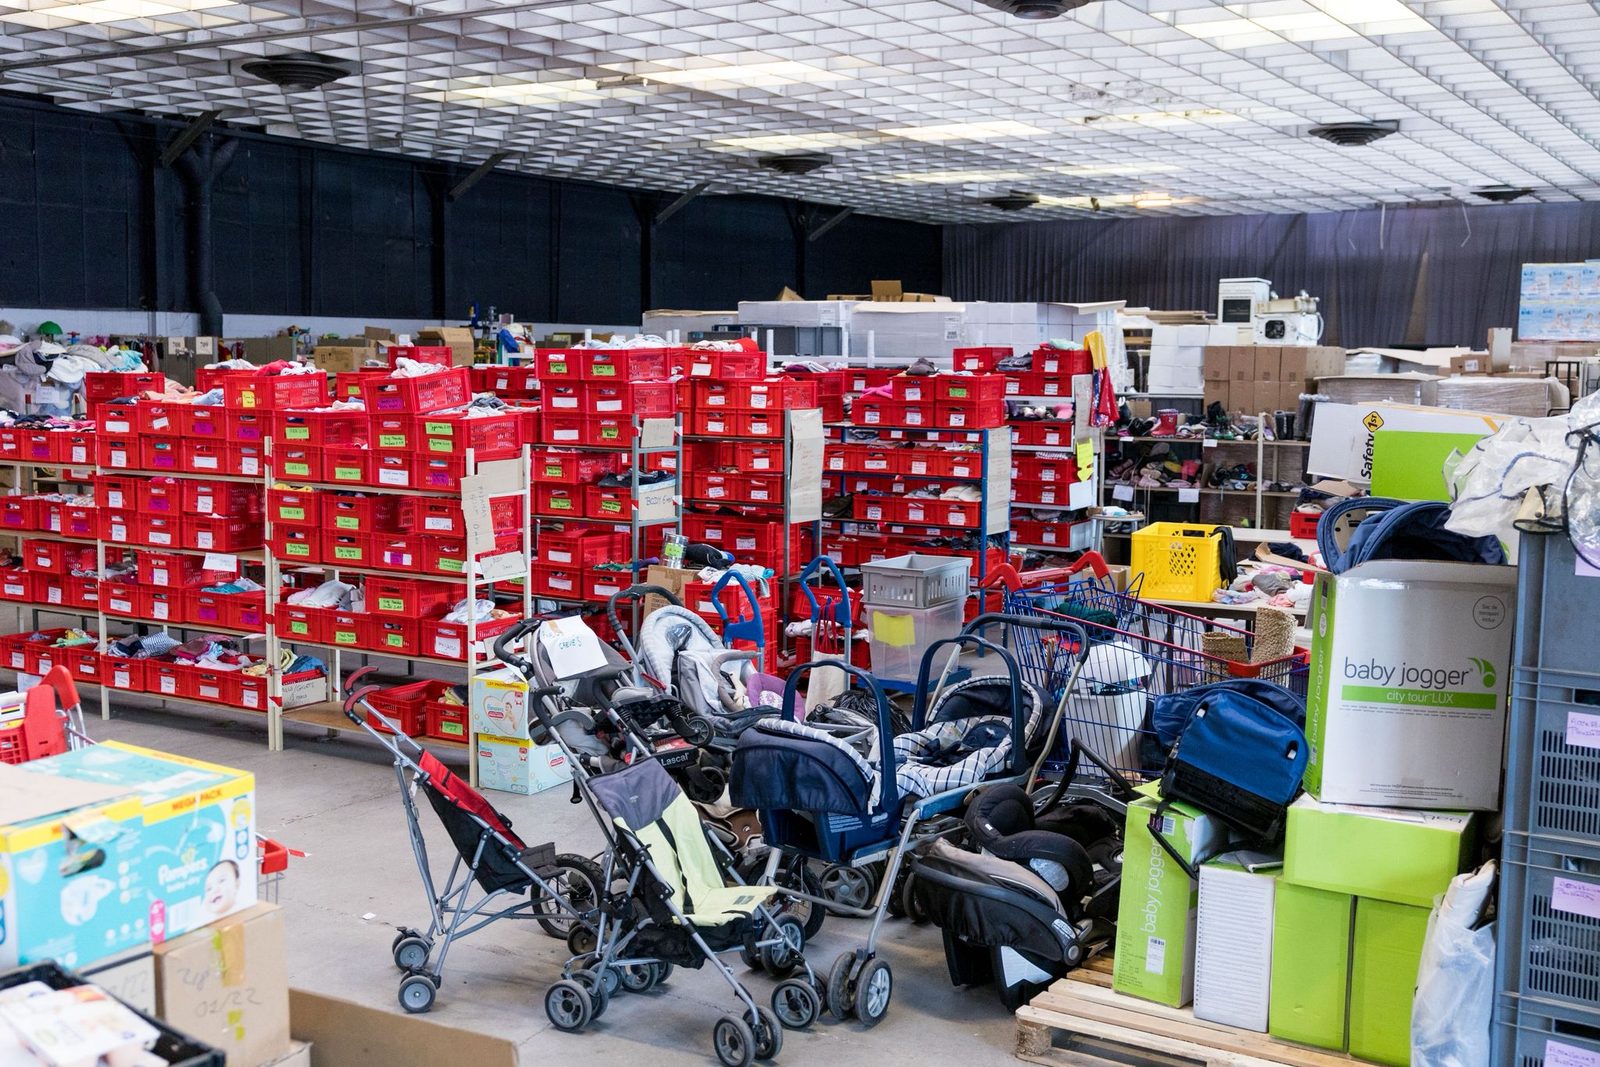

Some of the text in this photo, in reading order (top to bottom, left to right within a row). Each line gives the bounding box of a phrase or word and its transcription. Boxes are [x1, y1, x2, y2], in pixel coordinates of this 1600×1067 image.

[1344, 656, 1469, 690] baby jogger
[1386, 690, 1454, 704] city tour LUX
[1140, 839, 1165, 933] baby jogger
